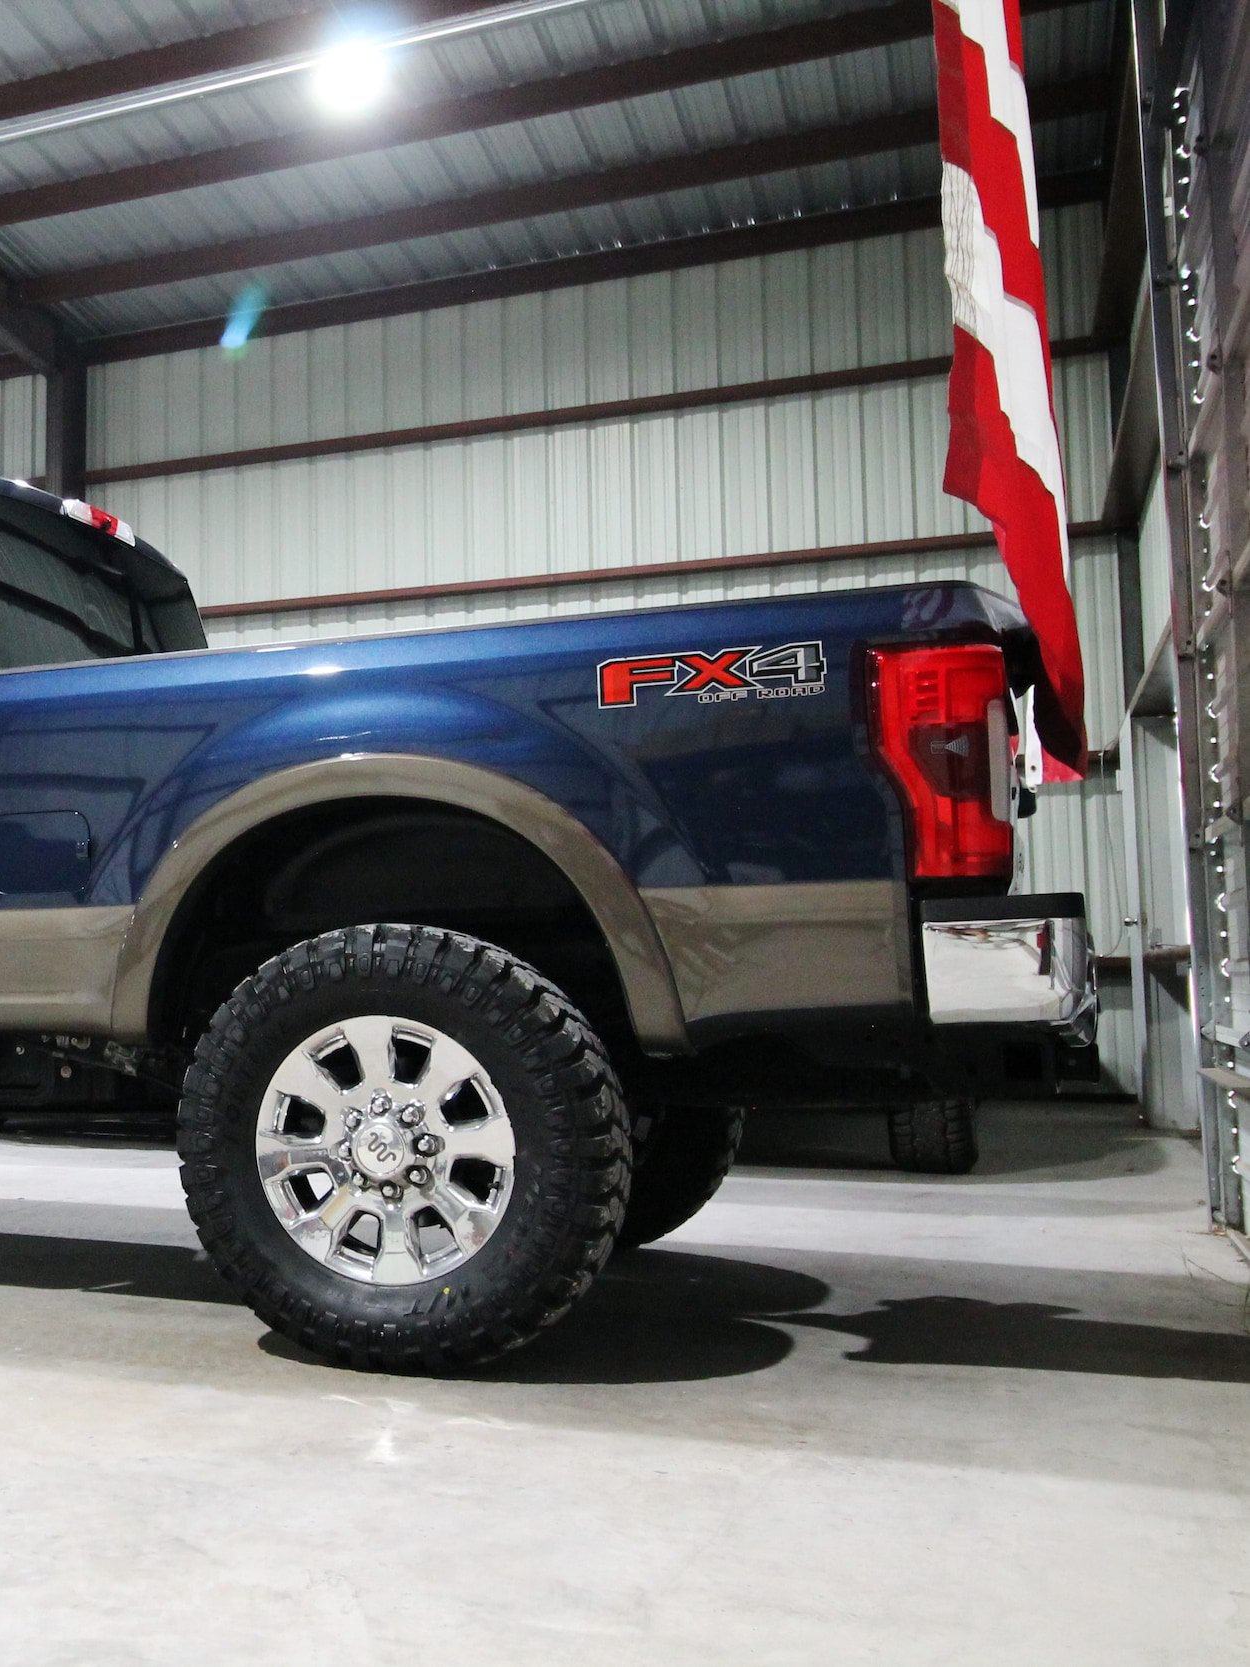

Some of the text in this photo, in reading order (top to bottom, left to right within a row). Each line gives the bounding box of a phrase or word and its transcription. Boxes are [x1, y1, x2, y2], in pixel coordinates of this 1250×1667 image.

[597, 640, 827, 709] FX4
[698, 684, 826, 704] OFF ROAD
